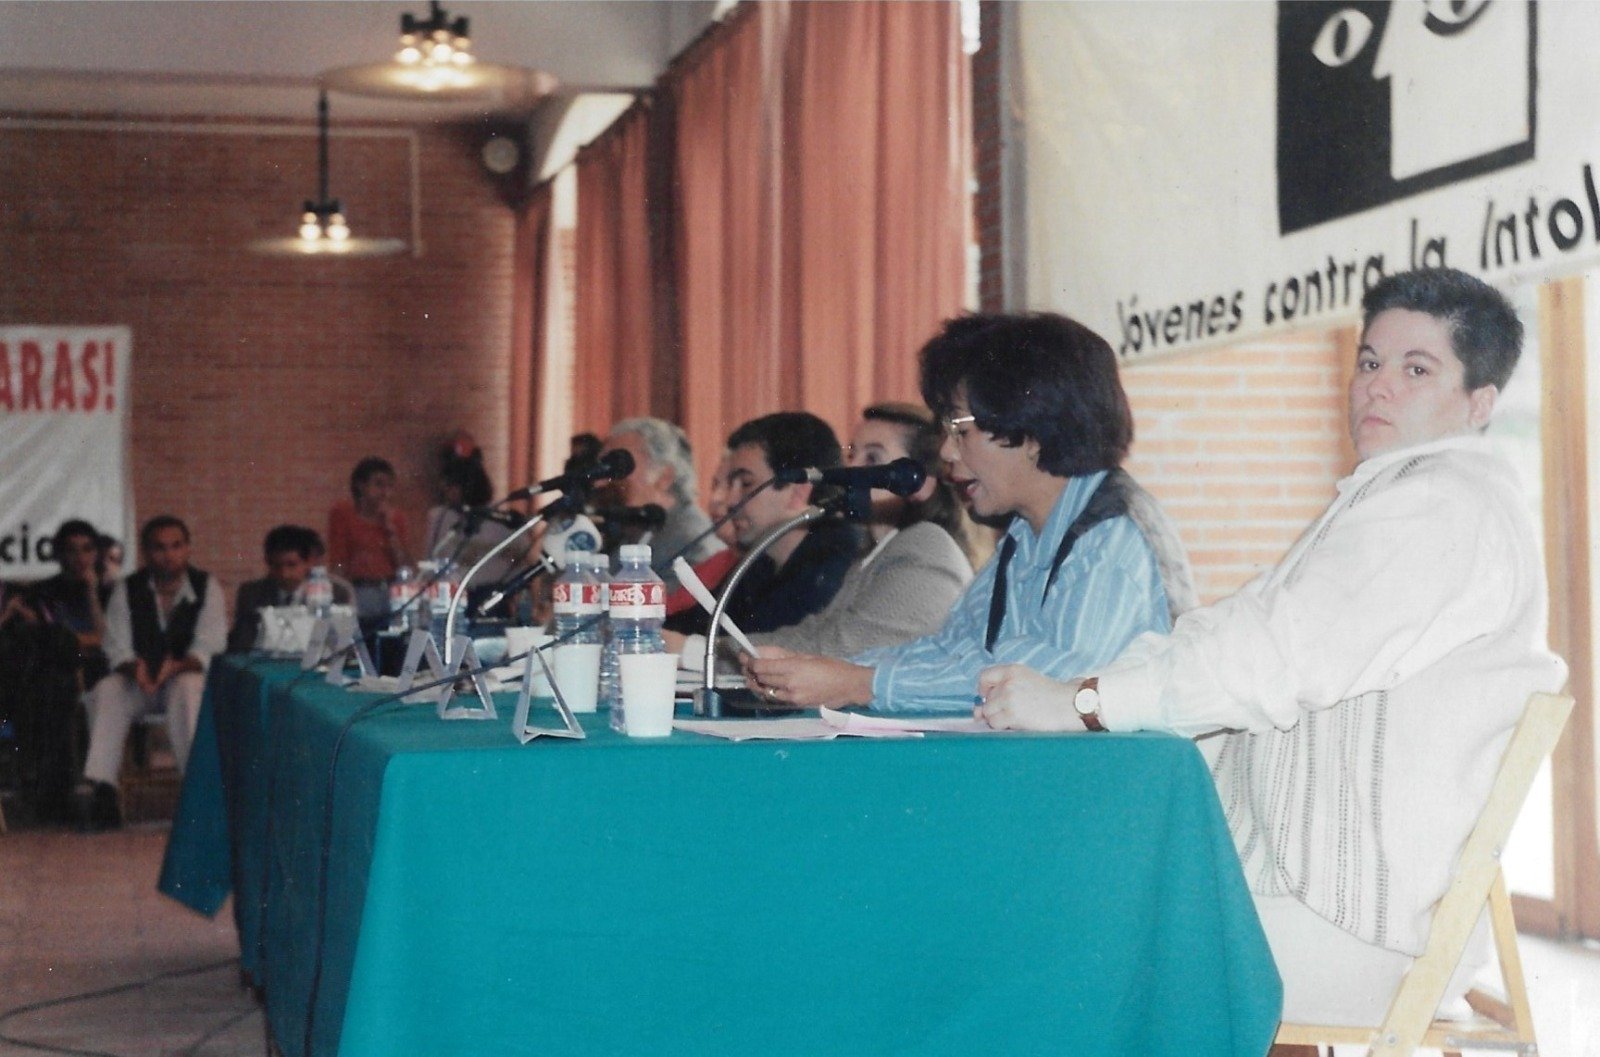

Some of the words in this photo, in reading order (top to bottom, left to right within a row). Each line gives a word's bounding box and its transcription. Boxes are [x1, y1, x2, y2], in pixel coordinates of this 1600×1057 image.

[1116, 290, 1244, 357] Jóvenes
[1264, 253, 1385, 324] contra
[1410, 218, 1446, 271] la
[1480, 164, 1600, 270] Intol
